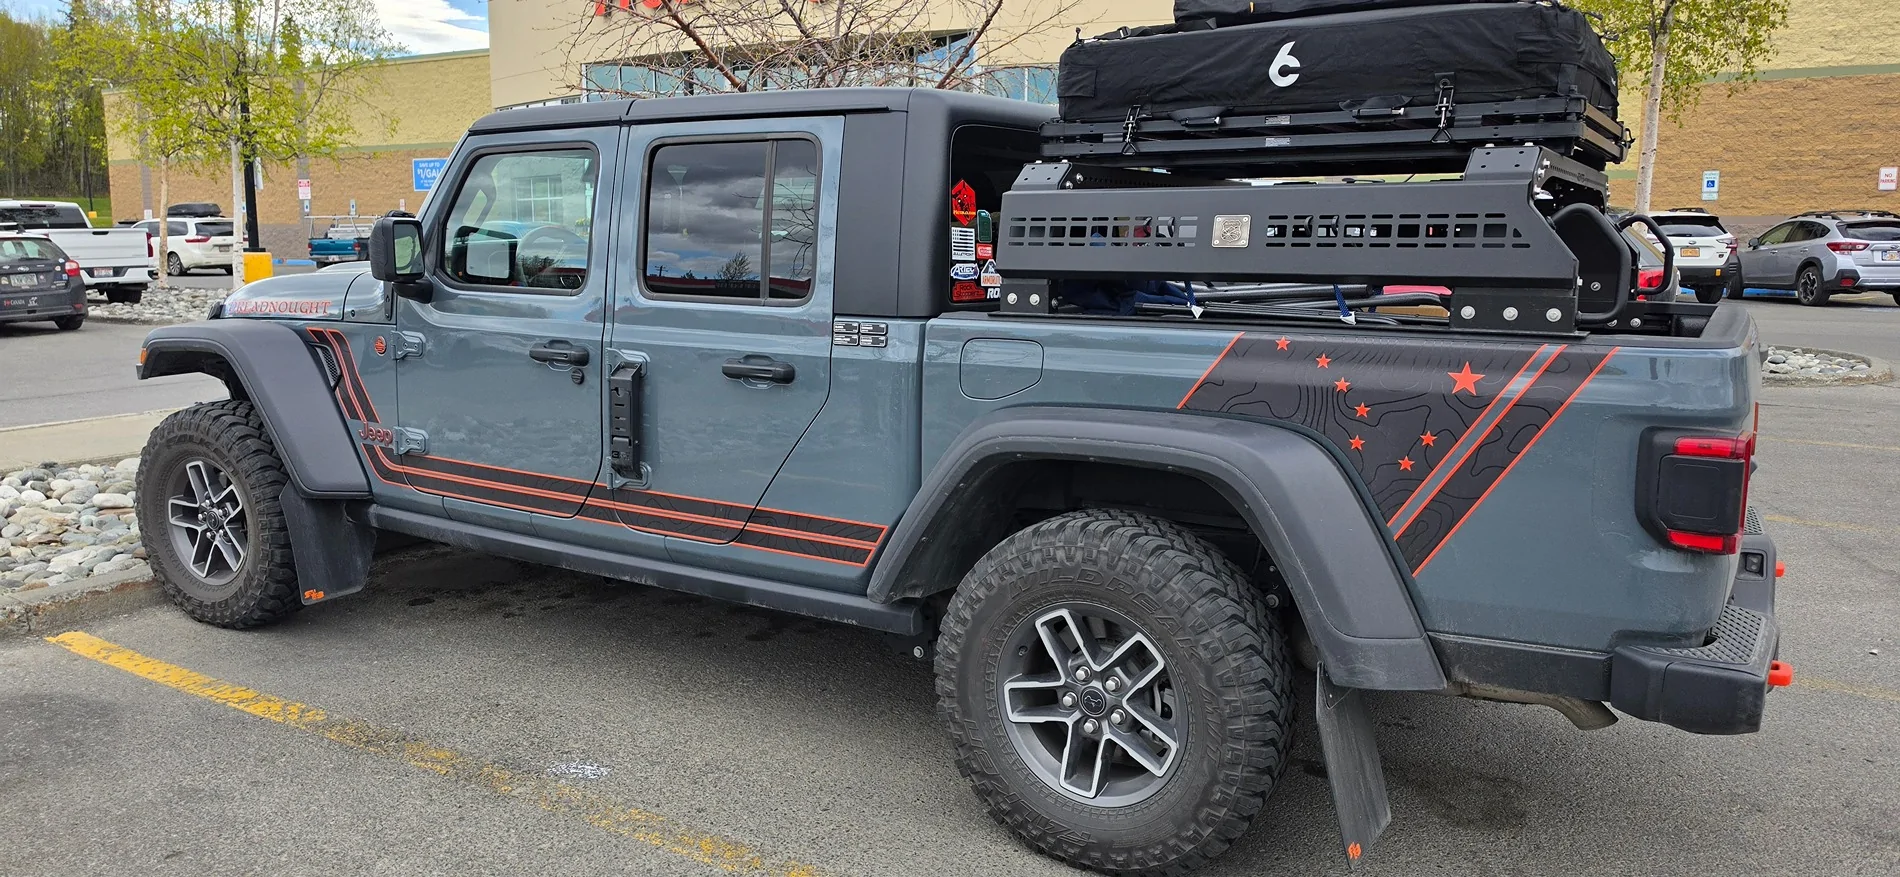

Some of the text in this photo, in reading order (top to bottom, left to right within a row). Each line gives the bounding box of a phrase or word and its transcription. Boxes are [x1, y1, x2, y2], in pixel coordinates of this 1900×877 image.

[228, 300, 331, 315] DREADNOUGHT
[358, 421, 393, 447] Jeep
[1008, 567, 1204, 665] WILDPEAK
